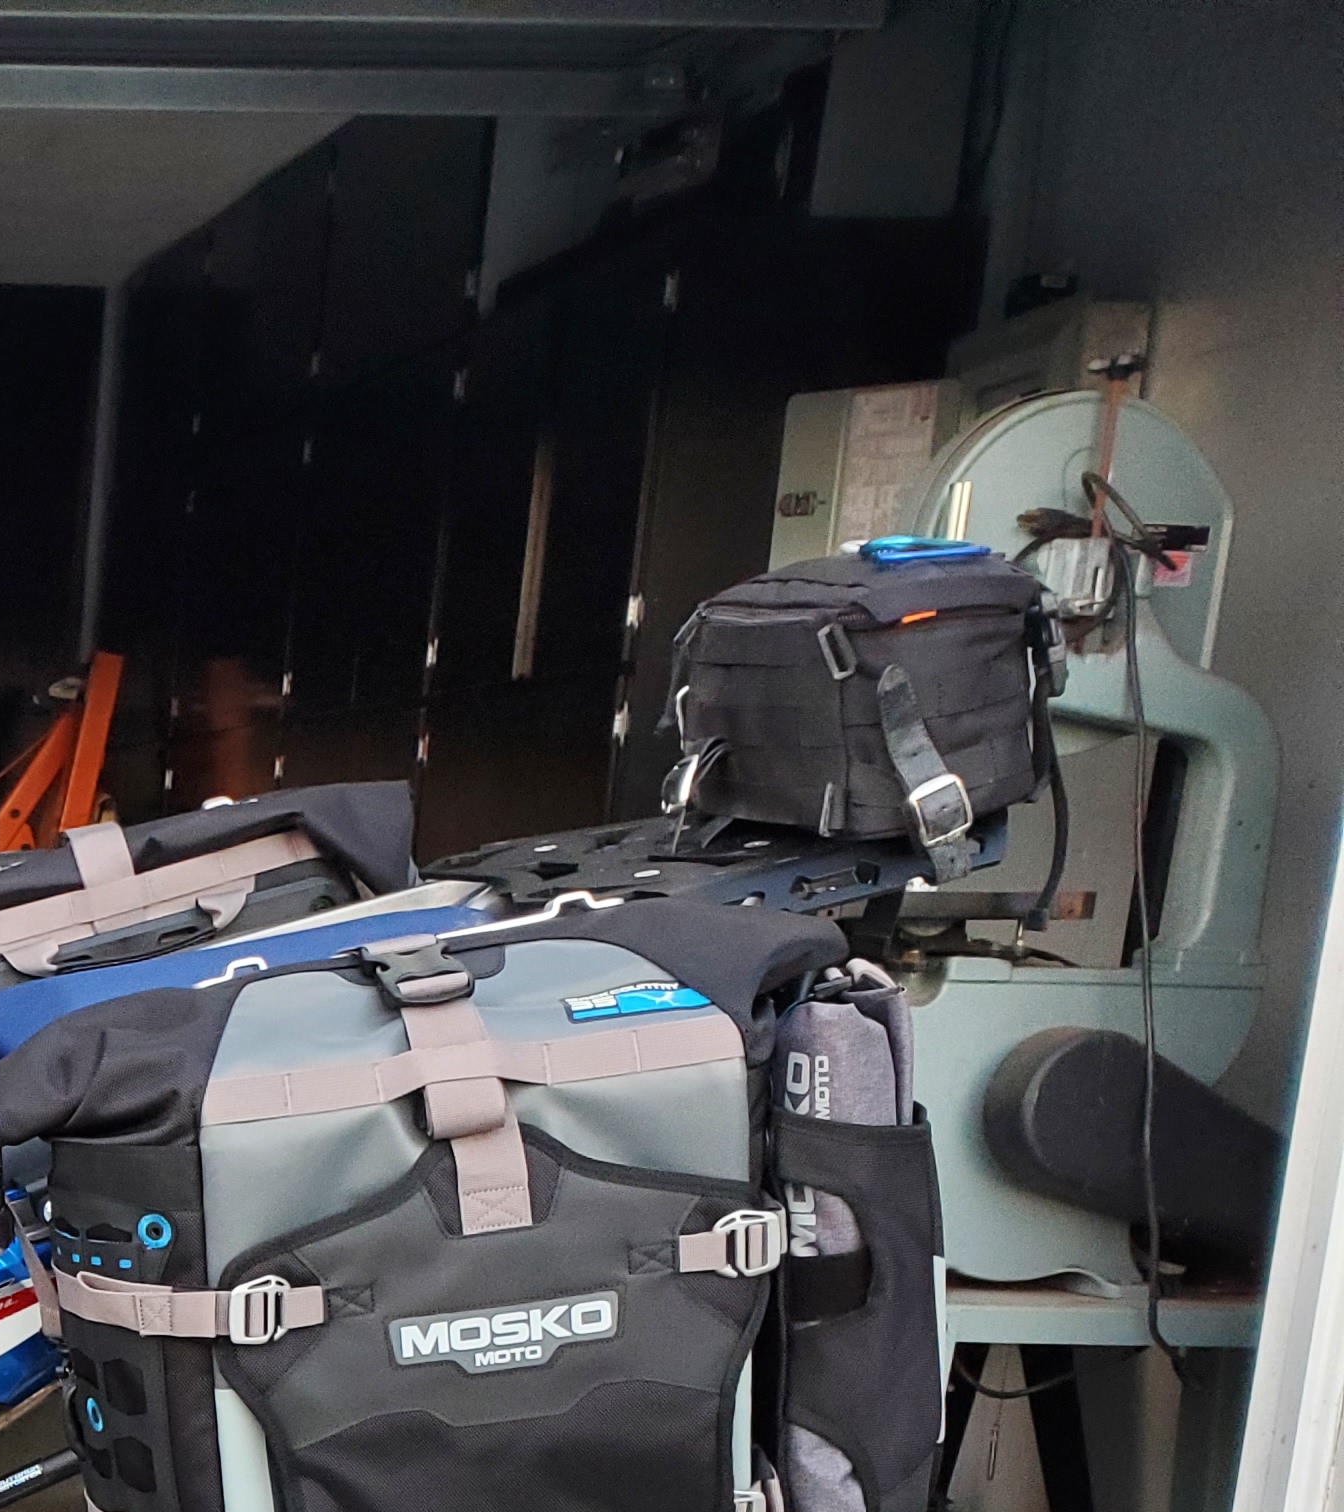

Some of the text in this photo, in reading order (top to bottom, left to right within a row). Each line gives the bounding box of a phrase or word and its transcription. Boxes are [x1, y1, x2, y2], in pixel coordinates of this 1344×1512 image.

[814, 1055, 832, 1120] MOTO
[399, 1299, 613, 1359] MOSKO
[474, 1345, 543, 1367] MOTO
